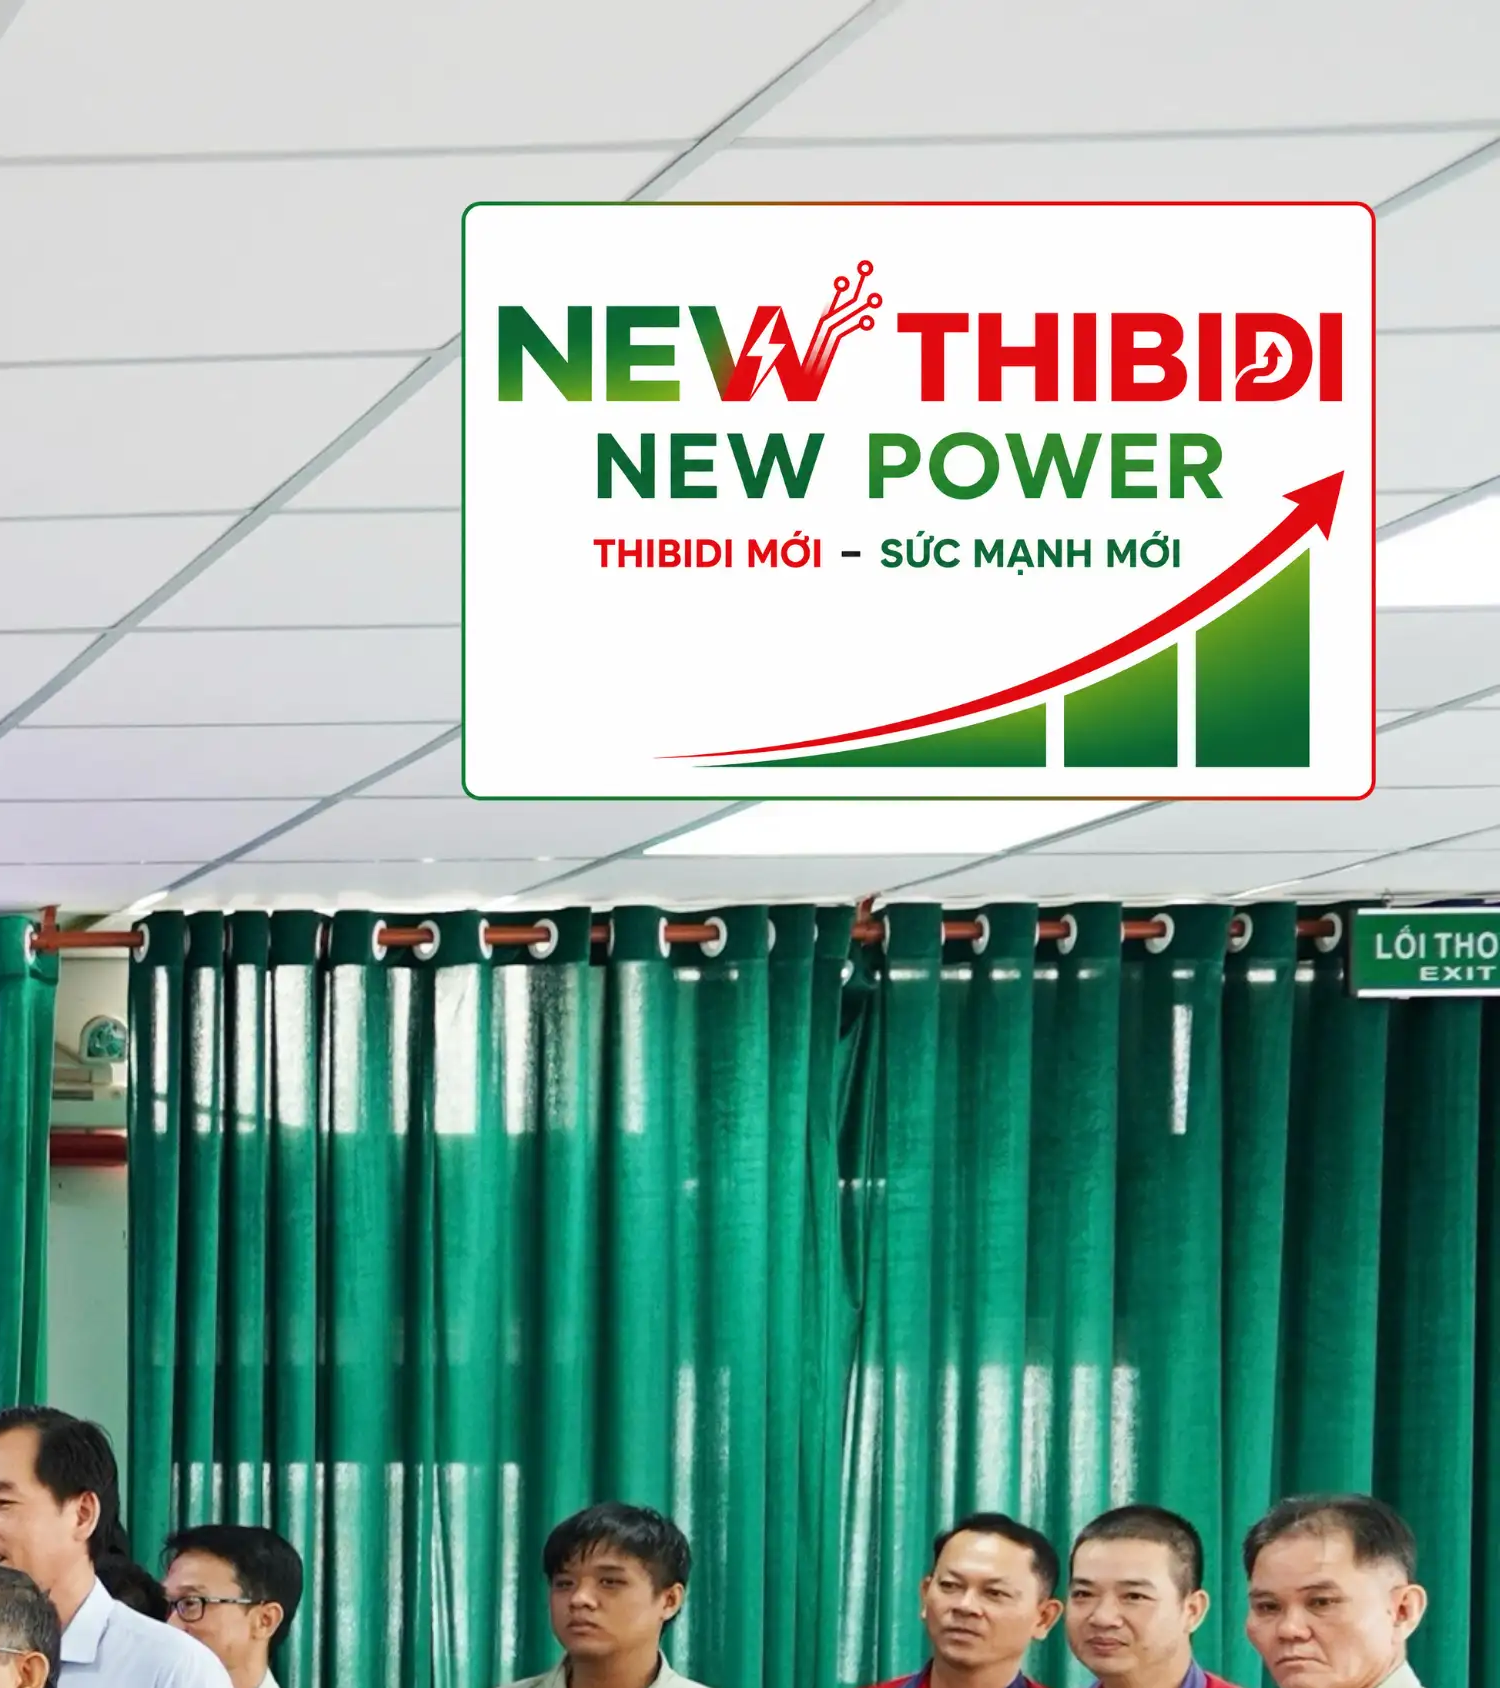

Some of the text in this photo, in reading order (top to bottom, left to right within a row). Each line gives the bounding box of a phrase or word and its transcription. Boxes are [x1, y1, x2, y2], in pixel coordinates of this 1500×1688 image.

[1376, 924, 1500, 960] LỐI THO
[1420, 965, 1497, 981] EXIT
